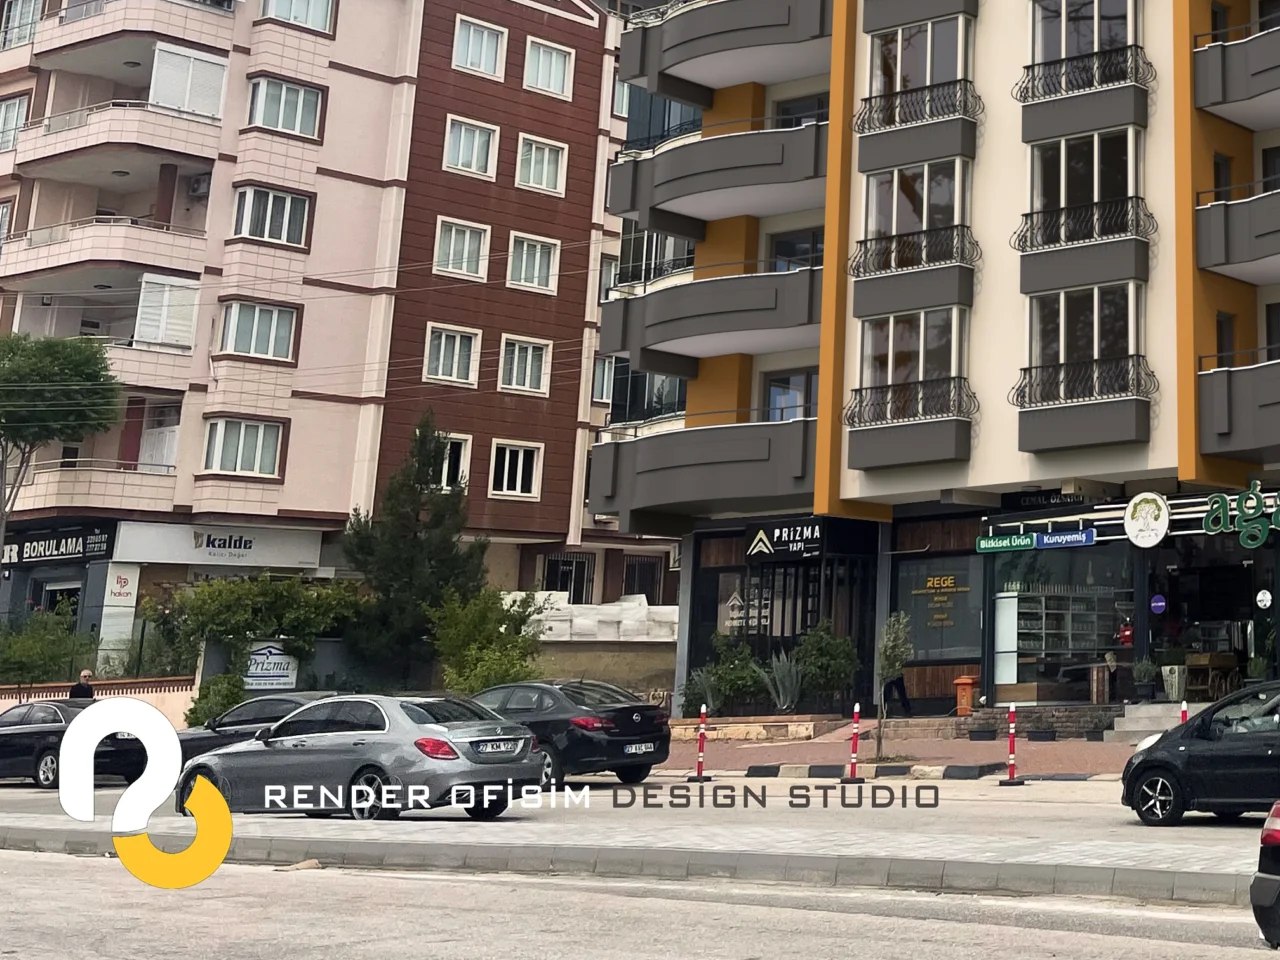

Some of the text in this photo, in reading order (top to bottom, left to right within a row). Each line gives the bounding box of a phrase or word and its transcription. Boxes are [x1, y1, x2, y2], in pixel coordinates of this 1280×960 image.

[206, 534, 253, 549] kalde
[980, 535, 1031, 548] Bitkisel Ürün
[1043, 531, 1087, 545] Kuruyemiş
[23, 537, 83, 558] BORULAMA
[789, 542, 804, 552] YAPI
[927, 576, 955, 588] REGE
[248, 657, 291, 672] Prizma
